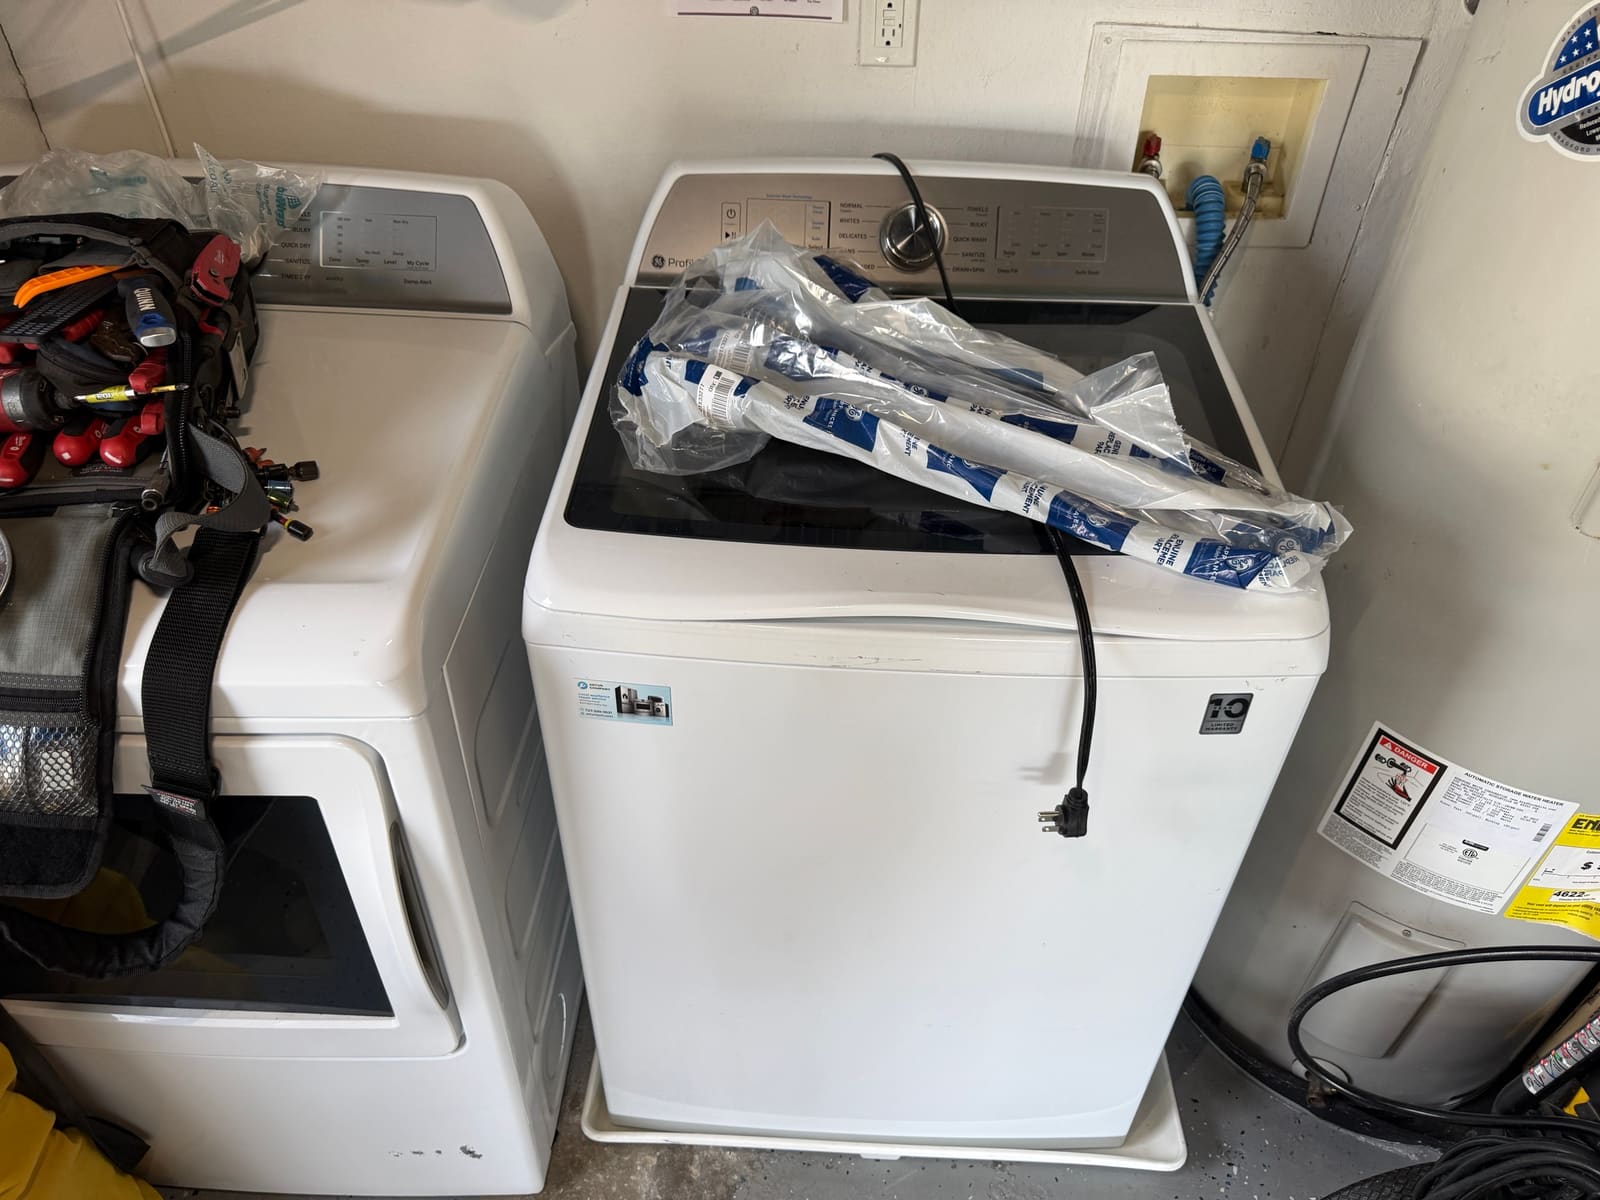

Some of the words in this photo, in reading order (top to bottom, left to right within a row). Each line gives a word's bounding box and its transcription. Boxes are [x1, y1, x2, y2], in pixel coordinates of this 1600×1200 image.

[1553, 131, 1592, 153] BRADFORD
[133, 286, 157, 313] QUINN
[1166, 538, 1185, 567] ENUINE
[1209, 697, 1250, 718] 10
[1394, 746, 1428, 769] DANGER
[1464, 772, 1496, 788] AUTOMATIC
[1496, 783, 1522, 797] STORAGE
[1522, 793, 1540, 801] WATER
[1540, 798, 1564, 807] HEATER
[1553, 890, 1585, 898] 4622
